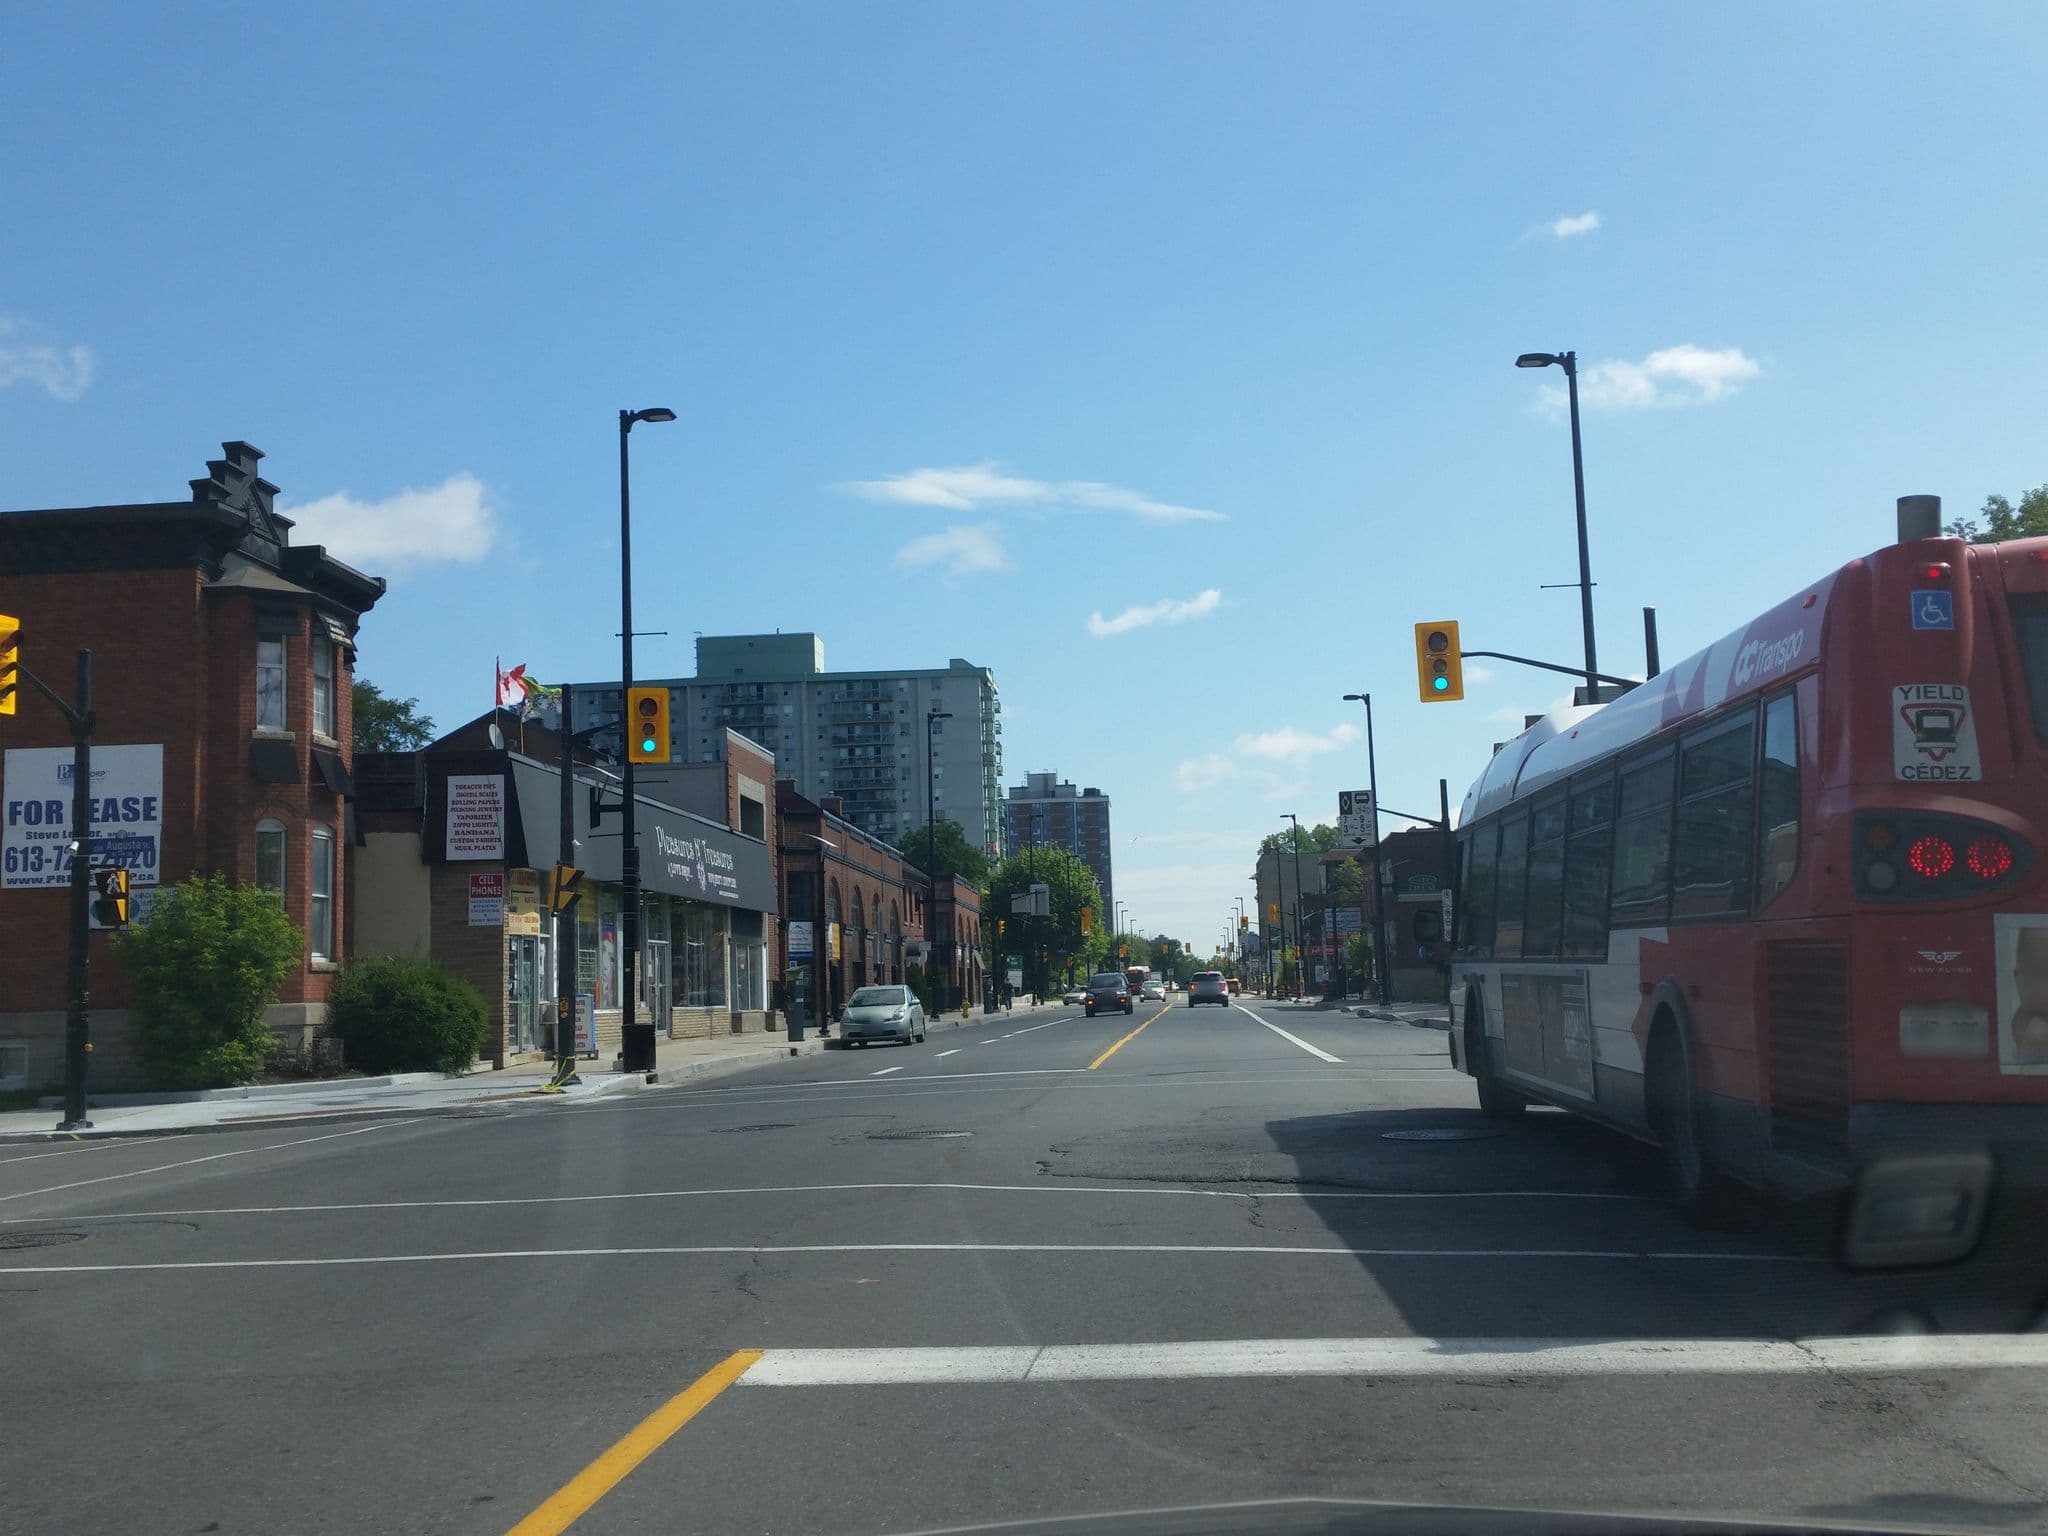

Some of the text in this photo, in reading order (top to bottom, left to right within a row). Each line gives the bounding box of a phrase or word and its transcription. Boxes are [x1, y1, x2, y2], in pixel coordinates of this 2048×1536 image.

[1755, 628, 1804, 677] Transpo
[1899, 685, 1964, 701] YIELD
[1901, 762, 1973, 780] CÉDEZ
[9, 797, 157, 826] FOR EASE
[25, 830, 60, 841] Steve
[478, 875, 495, 885] CELL
[471, 886, 502, 896] PHONES
